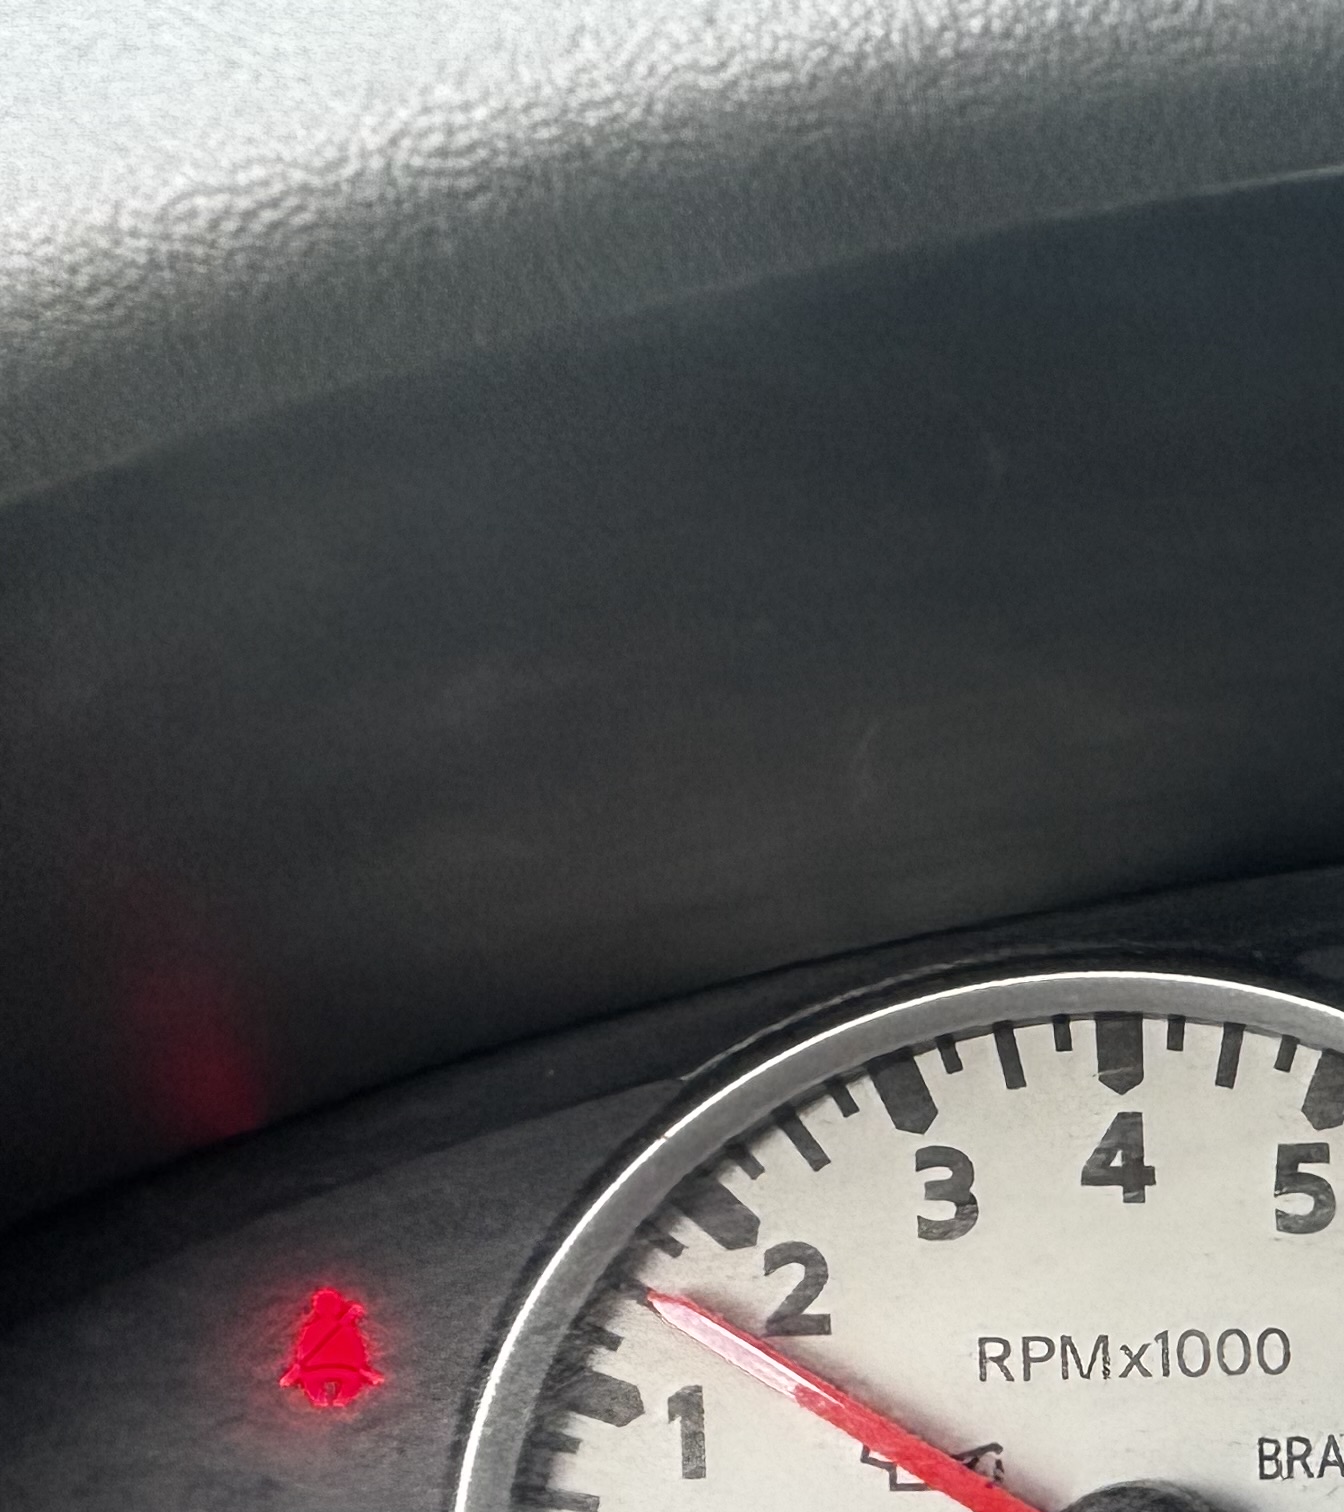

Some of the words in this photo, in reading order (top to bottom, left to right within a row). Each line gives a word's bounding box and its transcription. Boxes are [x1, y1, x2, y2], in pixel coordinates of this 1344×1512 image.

[915, 1145, 979, 1240] 3
[1080, 1111, 1156, 1204] 4
[1274, 1143, 1336, 1234] 5
[763, 1241, 832, 1337] 2
[977, 1327, 1291, 1382] RPMx1000
[667, 1386, 706, 1480] 1
